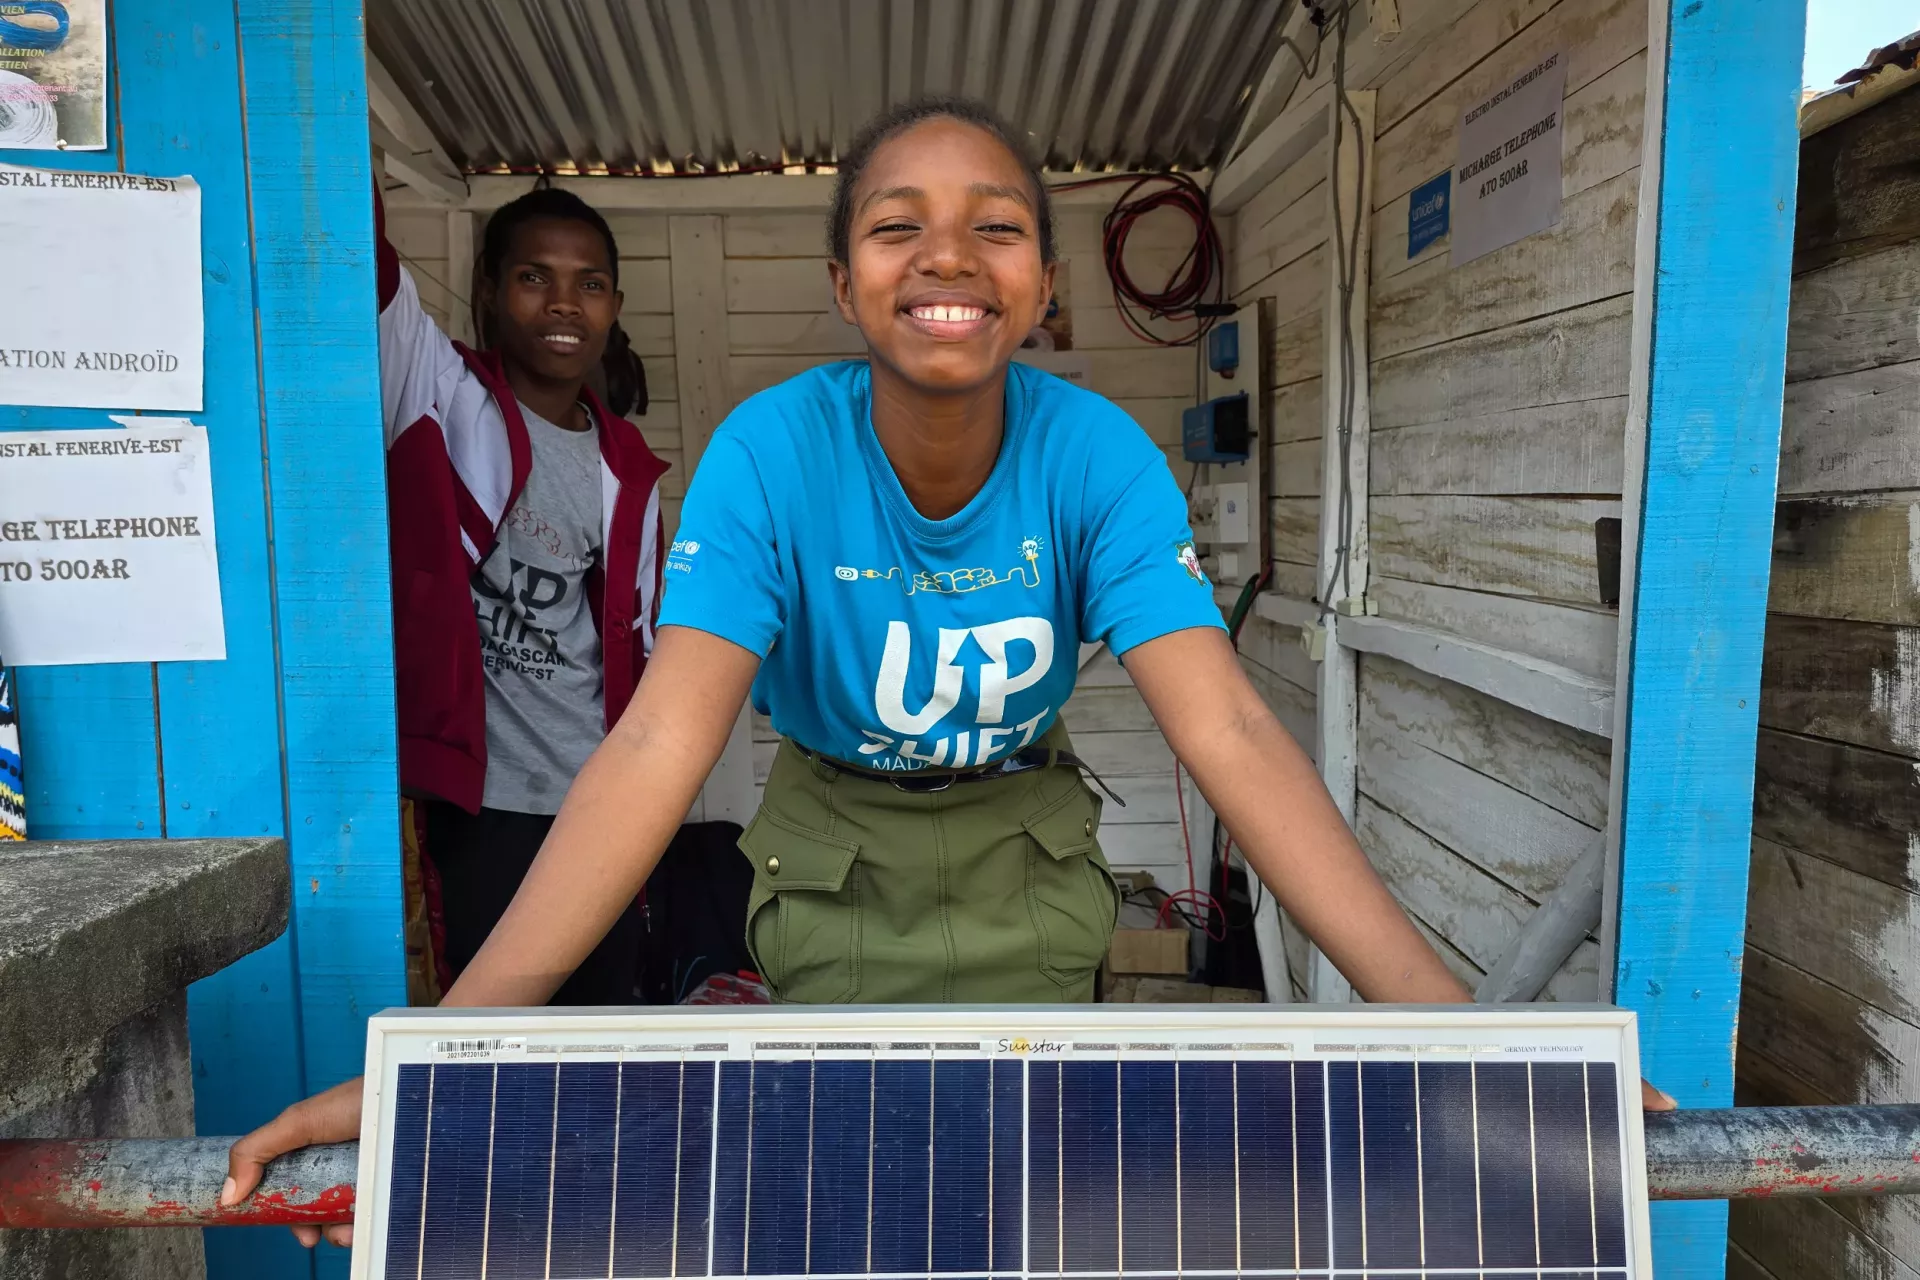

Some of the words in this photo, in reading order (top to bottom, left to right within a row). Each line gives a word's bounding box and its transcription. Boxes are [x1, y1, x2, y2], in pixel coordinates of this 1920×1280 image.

[0, 48, 45, 57] LLATION
[1465, 101, 1490, 126] ELECTRO
[1491, 86, 1511, 108] INSTAL
[1513, 52, 1559, 93] FENERIVE-EST
[1459, 145, 1502, 184] MICHARGE
[1504, 112, 1556, 157] TELEPHONE
[0, 172, 46, 187] STAL
[50, 173, 178, 192] FENERIVE-EST
[1479, 177, 1497, 199] ATO
[1499, 159, 1529, 188] 500AR
[1412, 194, 1436, 221] unicef
[74, 349, 179, 373] ANDROÏD
[55, 438, 182, 456] FENERIVE-EST
[0, 520, 41, 542] GE
[44, 516, 201, 540] TELEPHONE
[40, 558, 131, 581] 500AR
[875, 616, 1054, 735] UP
[997, 1038, 1067, 1054] Sunstar
[1504, 1044, 1537, 1053] GERMANY
[1539, 1044, 1584, 1052] TECHNOLOGY
